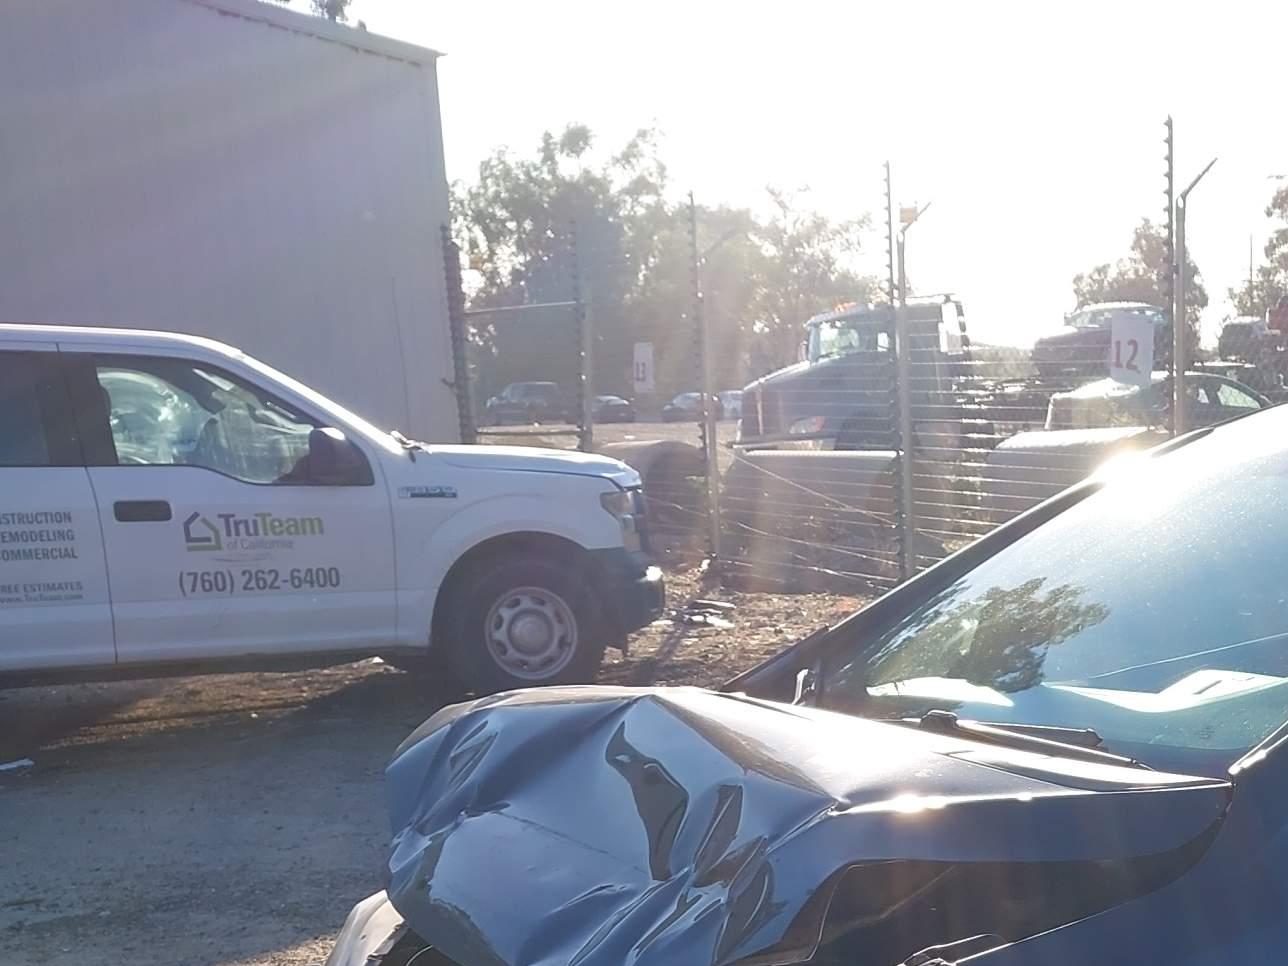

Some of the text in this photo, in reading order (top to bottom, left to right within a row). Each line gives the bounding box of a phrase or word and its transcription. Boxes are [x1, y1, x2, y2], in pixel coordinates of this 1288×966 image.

[1114, 338, 1138, 370] 12
[0, 511, 72, 525] STRUCTION
[217, 512, 324, 537] TruTeam
[0, 529, 75, 544] EMODELING
[0, 547, 79, 562] OMMERCIAL
[179, 566, 341, 597] (760) 262-6400
